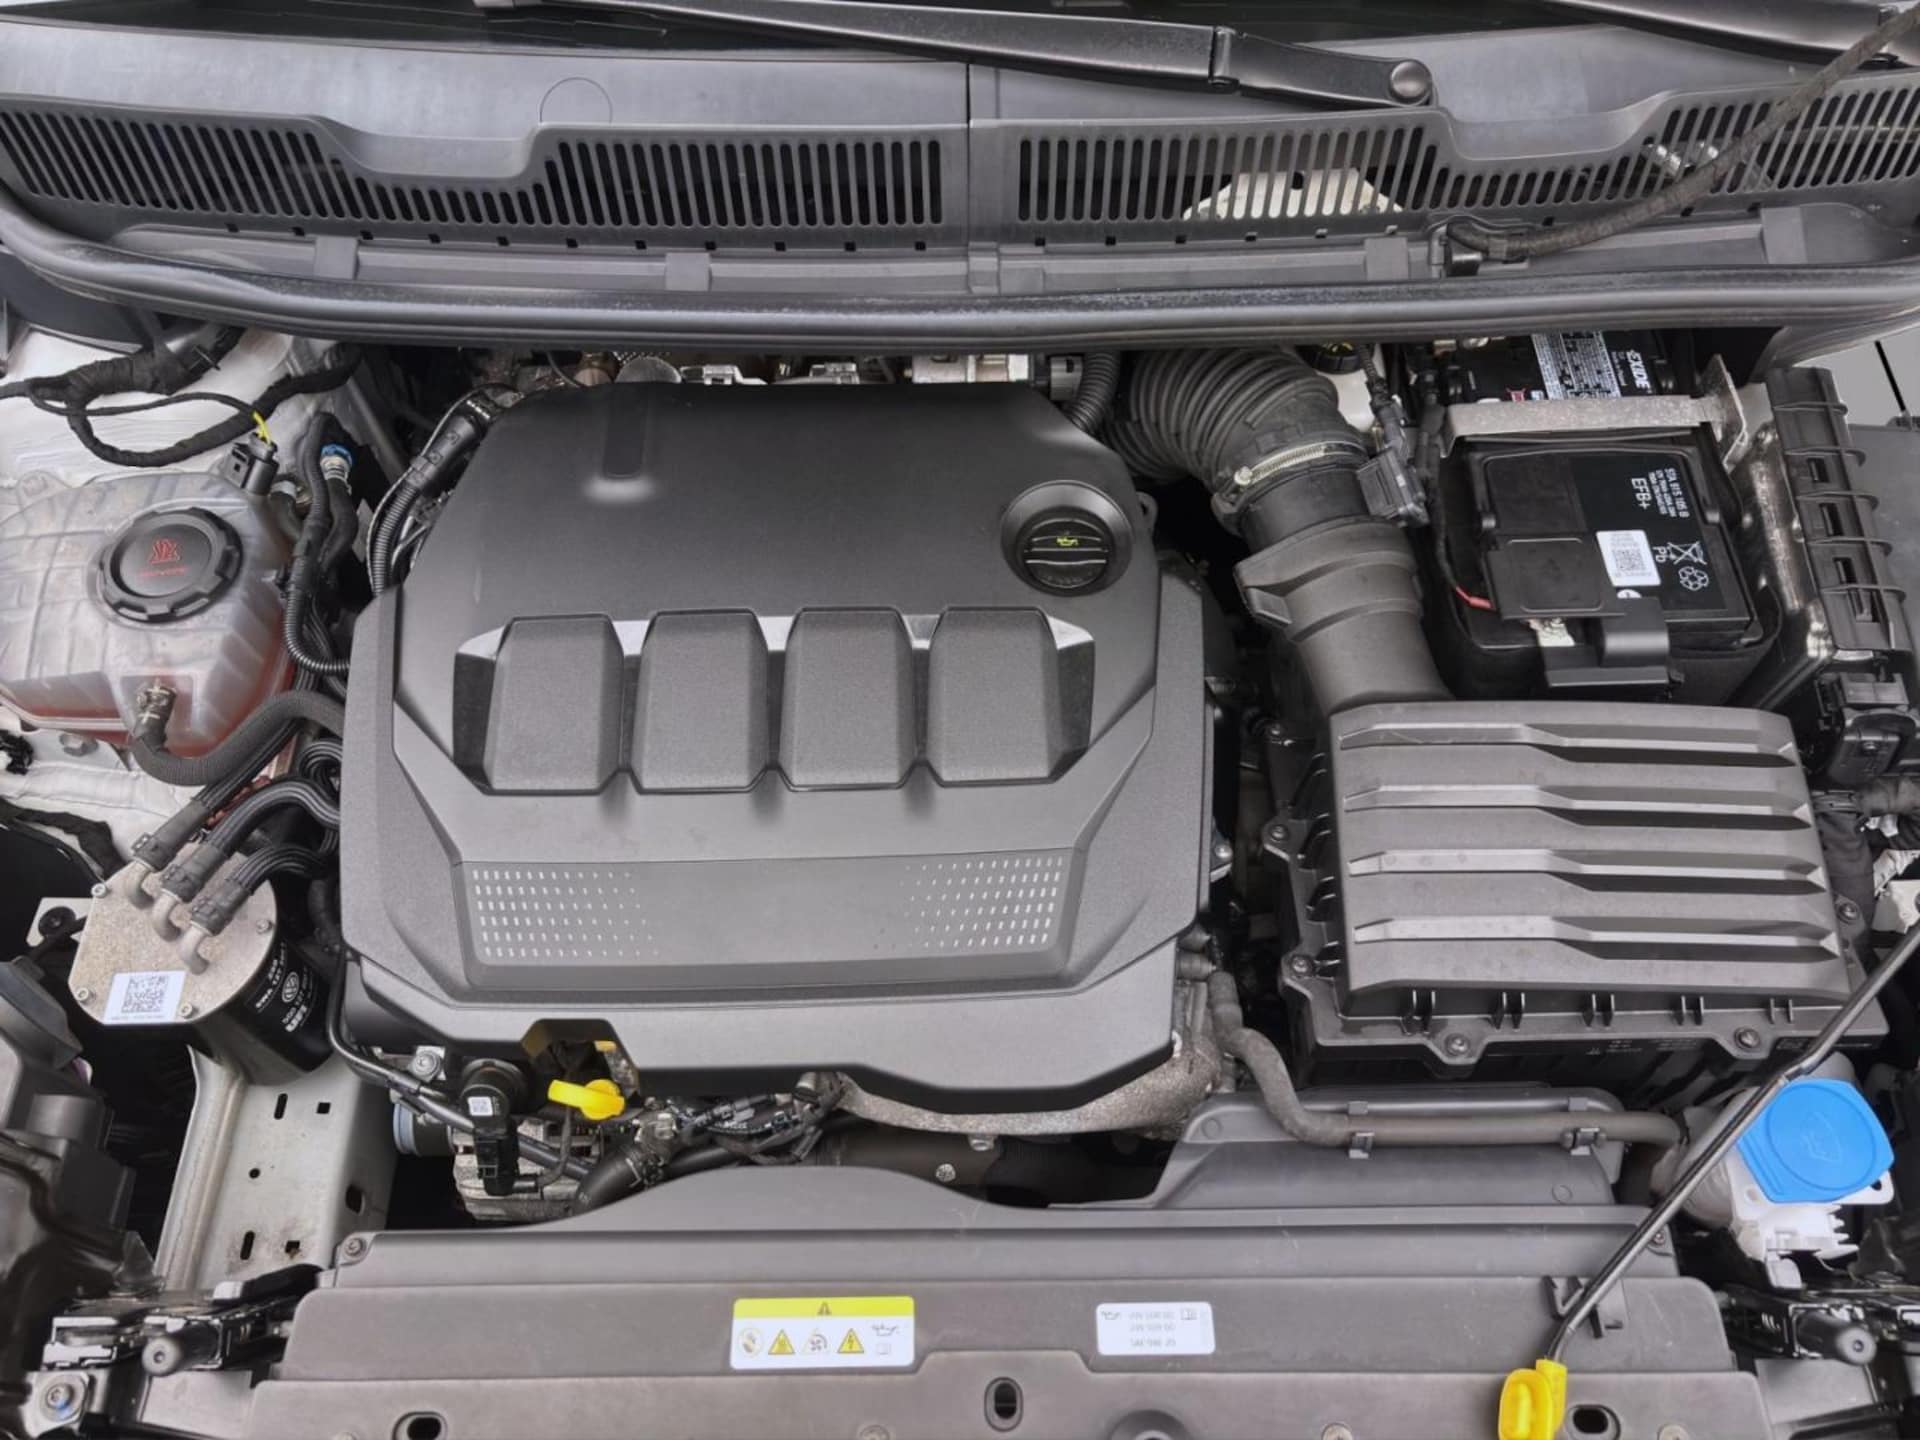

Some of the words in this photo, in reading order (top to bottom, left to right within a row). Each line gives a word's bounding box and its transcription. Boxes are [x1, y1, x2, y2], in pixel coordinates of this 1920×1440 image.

[1626, 349, 1651, 389] EXIDE
[1631, 477, 1652, 510] EFB+
[1652, 546, 1668, 563] Pb
